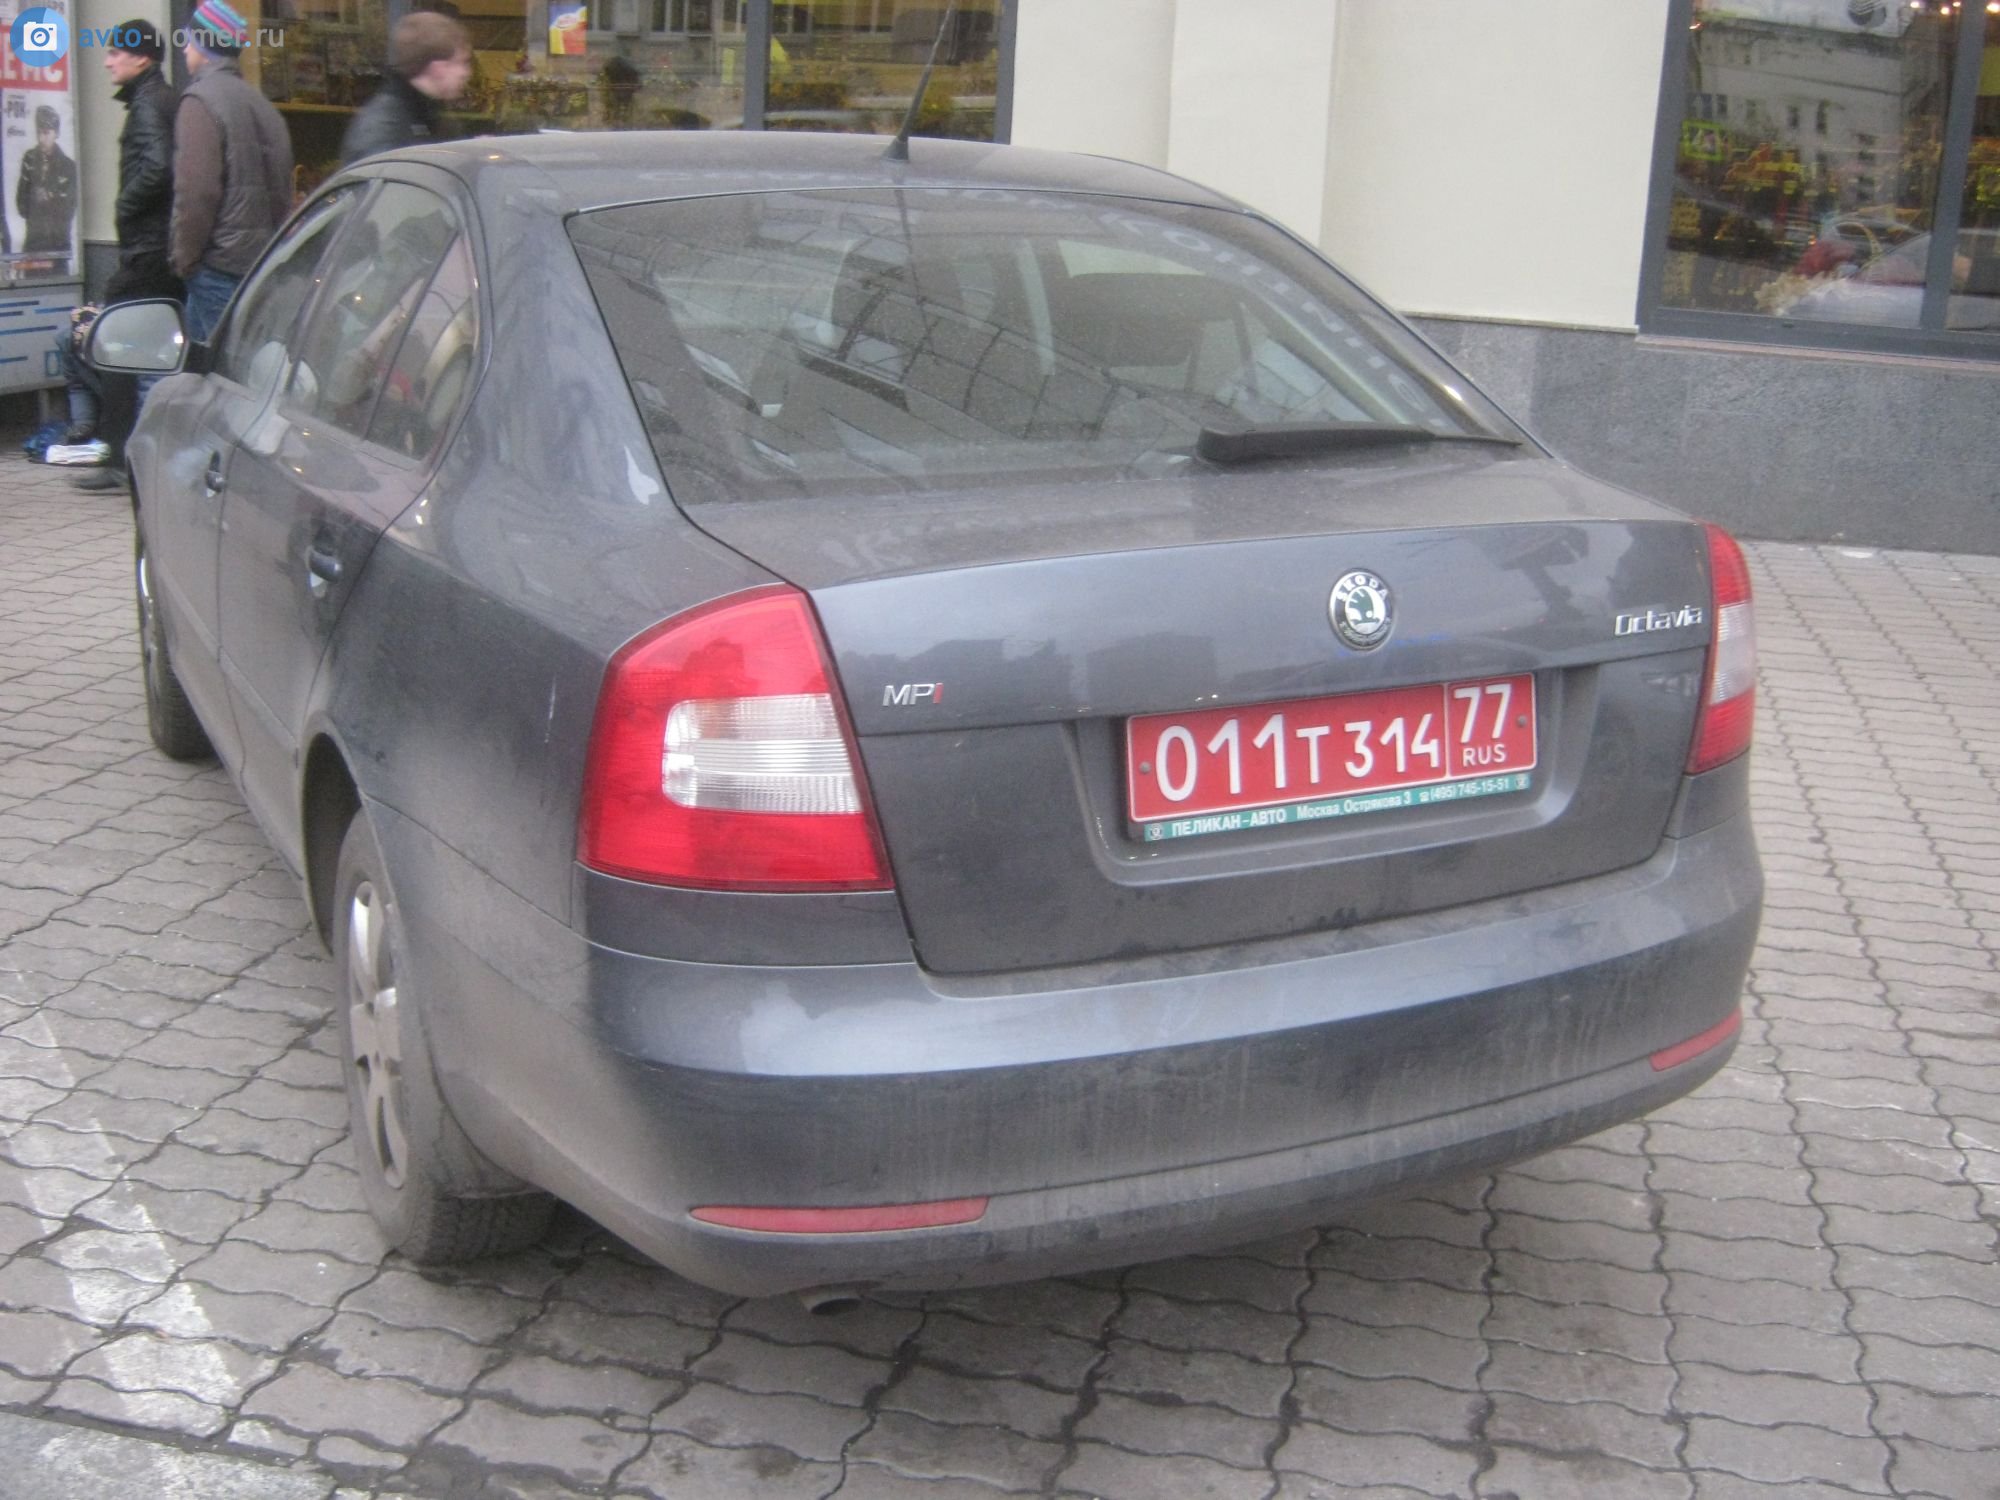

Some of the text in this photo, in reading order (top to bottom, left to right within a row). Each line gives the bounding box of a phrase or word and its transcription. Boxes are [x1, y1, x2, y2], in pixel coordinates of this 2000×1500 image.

[1615, 605, 1702, 636] Octavia
[1454, 684, 1511, 743] 77
[1462, 744, 1506, 767] RUS
